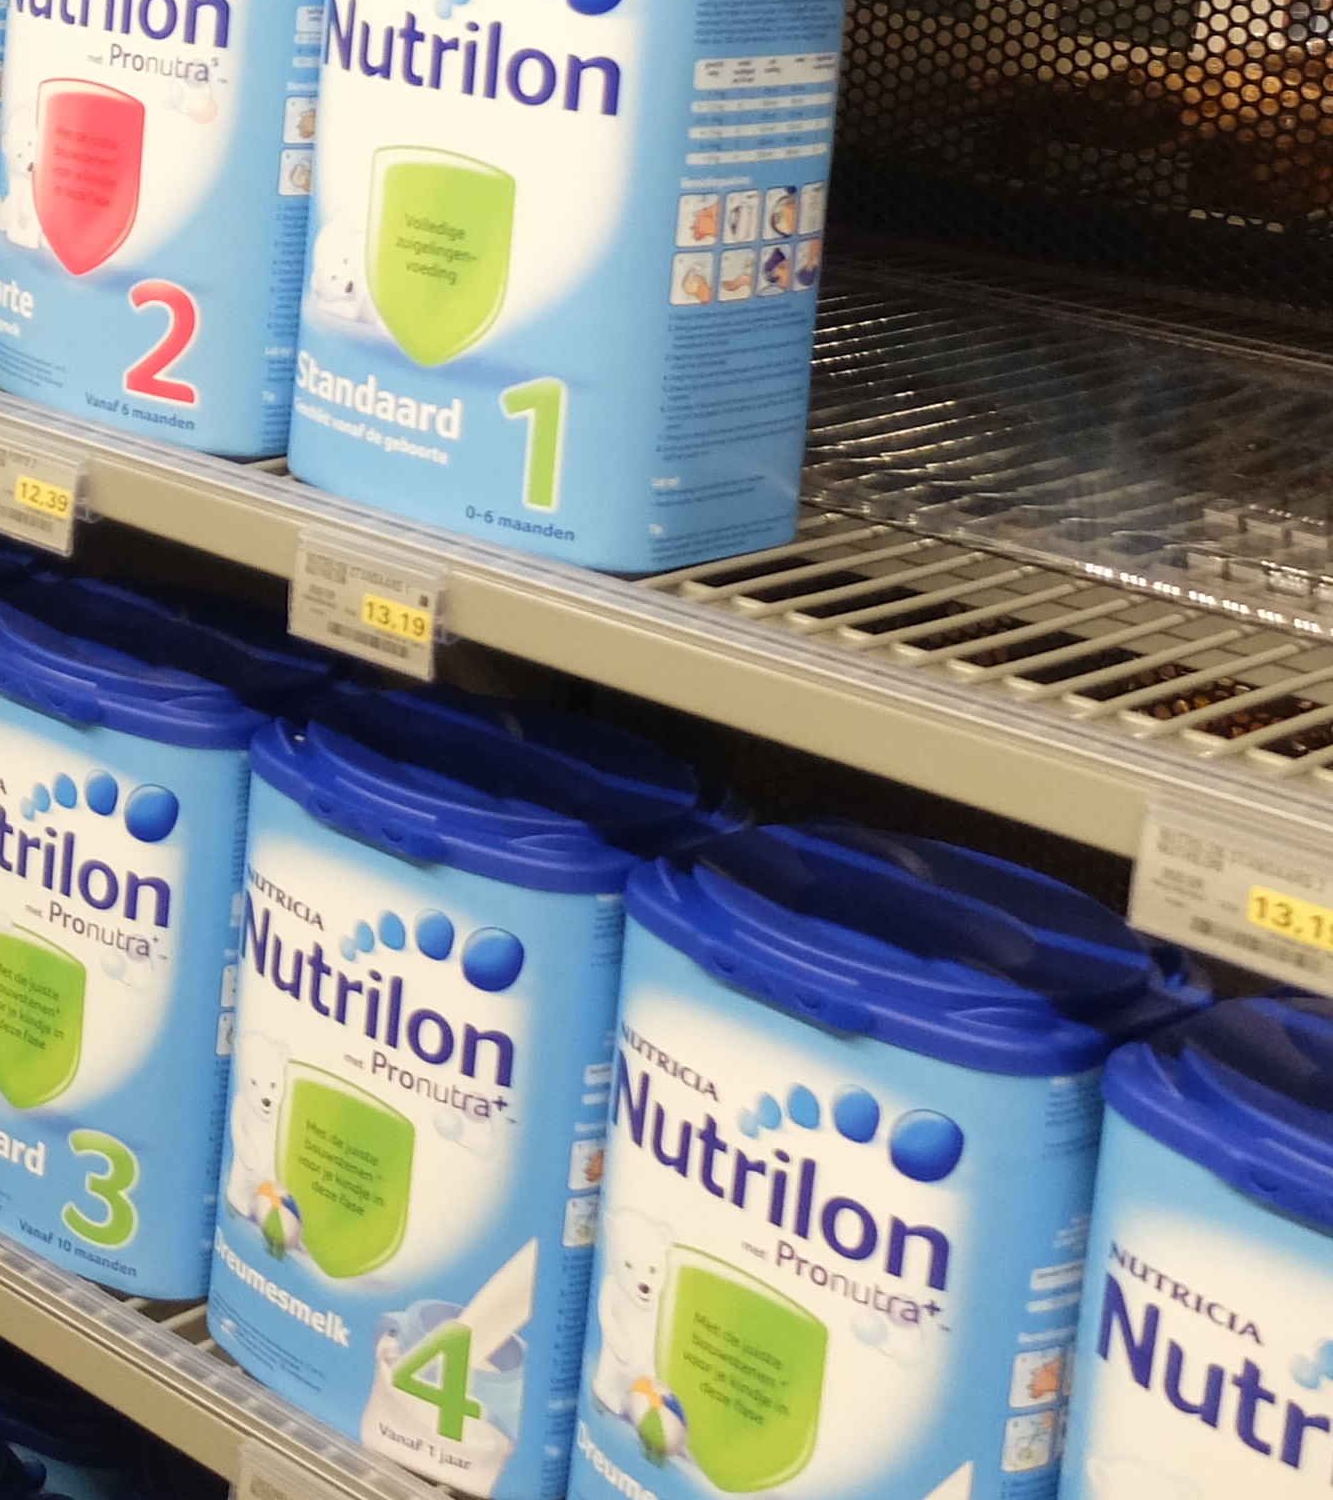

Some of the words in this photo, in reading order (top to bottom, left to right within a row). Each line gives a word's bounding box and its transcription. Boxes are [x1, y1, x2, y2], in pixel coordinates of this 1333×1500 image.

[405, 213, 465, 241] Volledige
[124, 279, 200, 406] 2
[296, 351, 463, 440] Standaard
[132, 408, 195, 432] maanden
[500, 377, 568, 513] 1
[498, 517, 575, 542] maanden
[242, 889, 514, 1088] Nutrilon
[61, 1128, 140, 1249] 3
[613, 1047, 950, 1292] Nutrilon
[74, 1243, 138, 1277] maanden
[215, 1226, 350, 1349] Dreumesmelk
[1110, 1240, 1264, 1347] NUTRICIA
[393, 1321, 481, 1442] 4
[1096, 1270, 1333, 1470] Nutr
[378, 1421, 423, 1452] Vanaf
[438, 1448, 472, 1472] jaar
